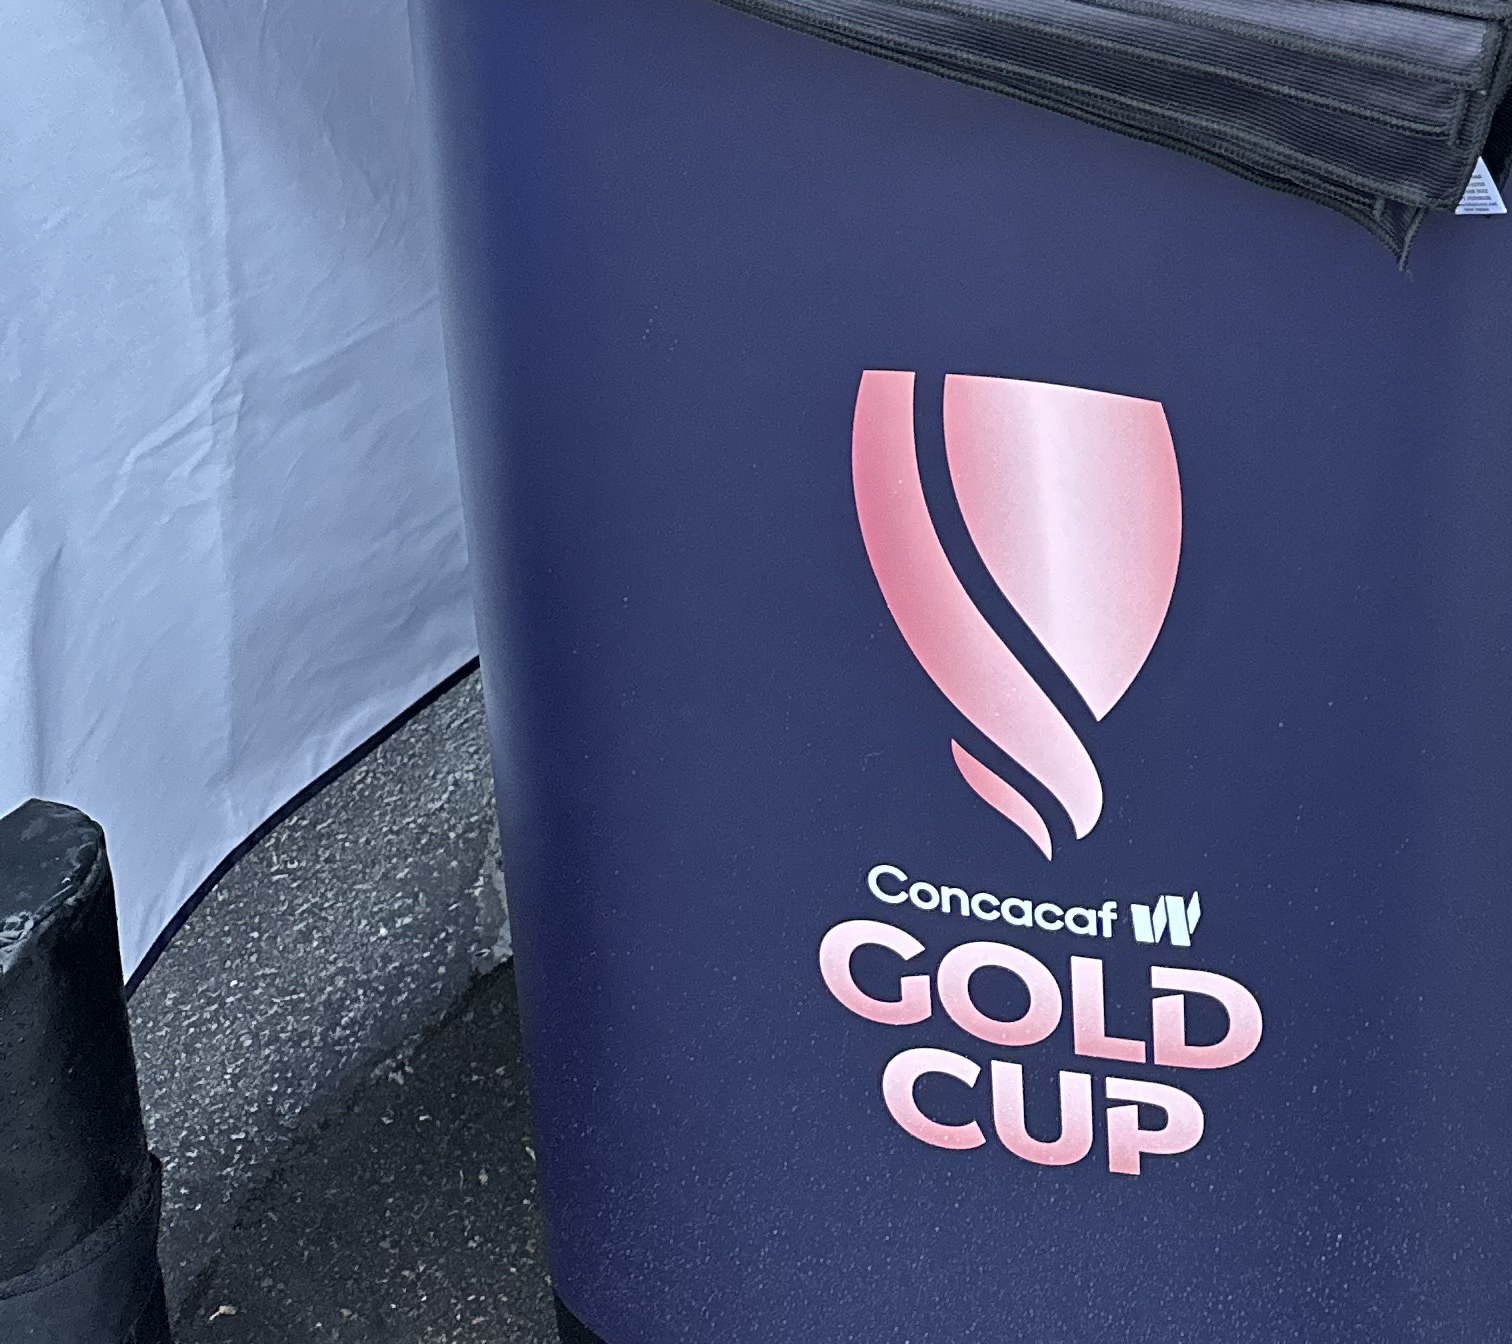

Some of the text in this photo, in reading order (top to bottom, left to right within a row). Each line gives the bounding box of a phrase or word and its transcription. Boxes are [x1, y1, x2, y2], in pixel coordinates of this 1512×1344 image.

[867, 864, 1118, 939] Concacaf
[819, 919, 1263, 1069] GOLD
[882, 1047, 1205, 1176] CUP
